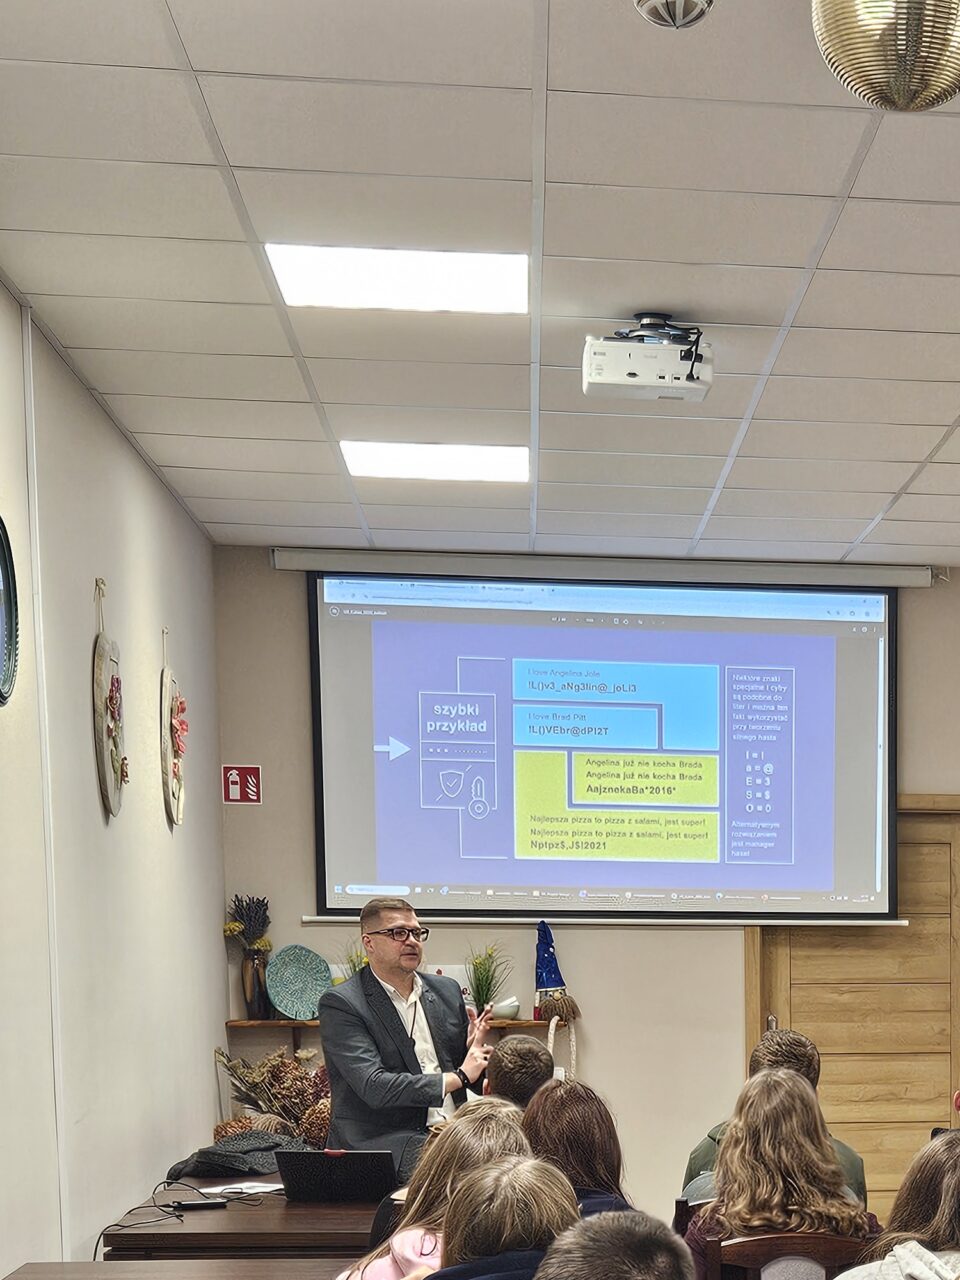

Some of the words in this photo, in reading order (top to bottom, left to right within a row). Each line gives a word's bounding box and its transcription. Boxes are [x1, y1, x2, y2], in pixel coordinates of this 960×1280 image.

[433, 702, 479, 718] szybki
[552, 713, 571, 721] Brad
[573, 713, 586, 721] Pitt
[426, 719, 487, 735] przykład
[586, 758, 620, 767] Angelina
[653, 760, 676, 768] kocha
[680, 761, 702, 769] Brada
[586, 771, 620, 780] Angelina
[623, 771, 635, 781] już
[680, 773, 702, 781] Brada
[530, 815, 569, 825] Najlepsza
[571, 816, 592, 825] pizza
[605, 817, 625, 825] pizza
[664, 818, 679, 827] jest
[530, 828, 569, 838] Najlepsza
[571, 829, 593, 837] pizza
[605, 830, 626, 838] pizza
[666, 832, 681, 840] jest
